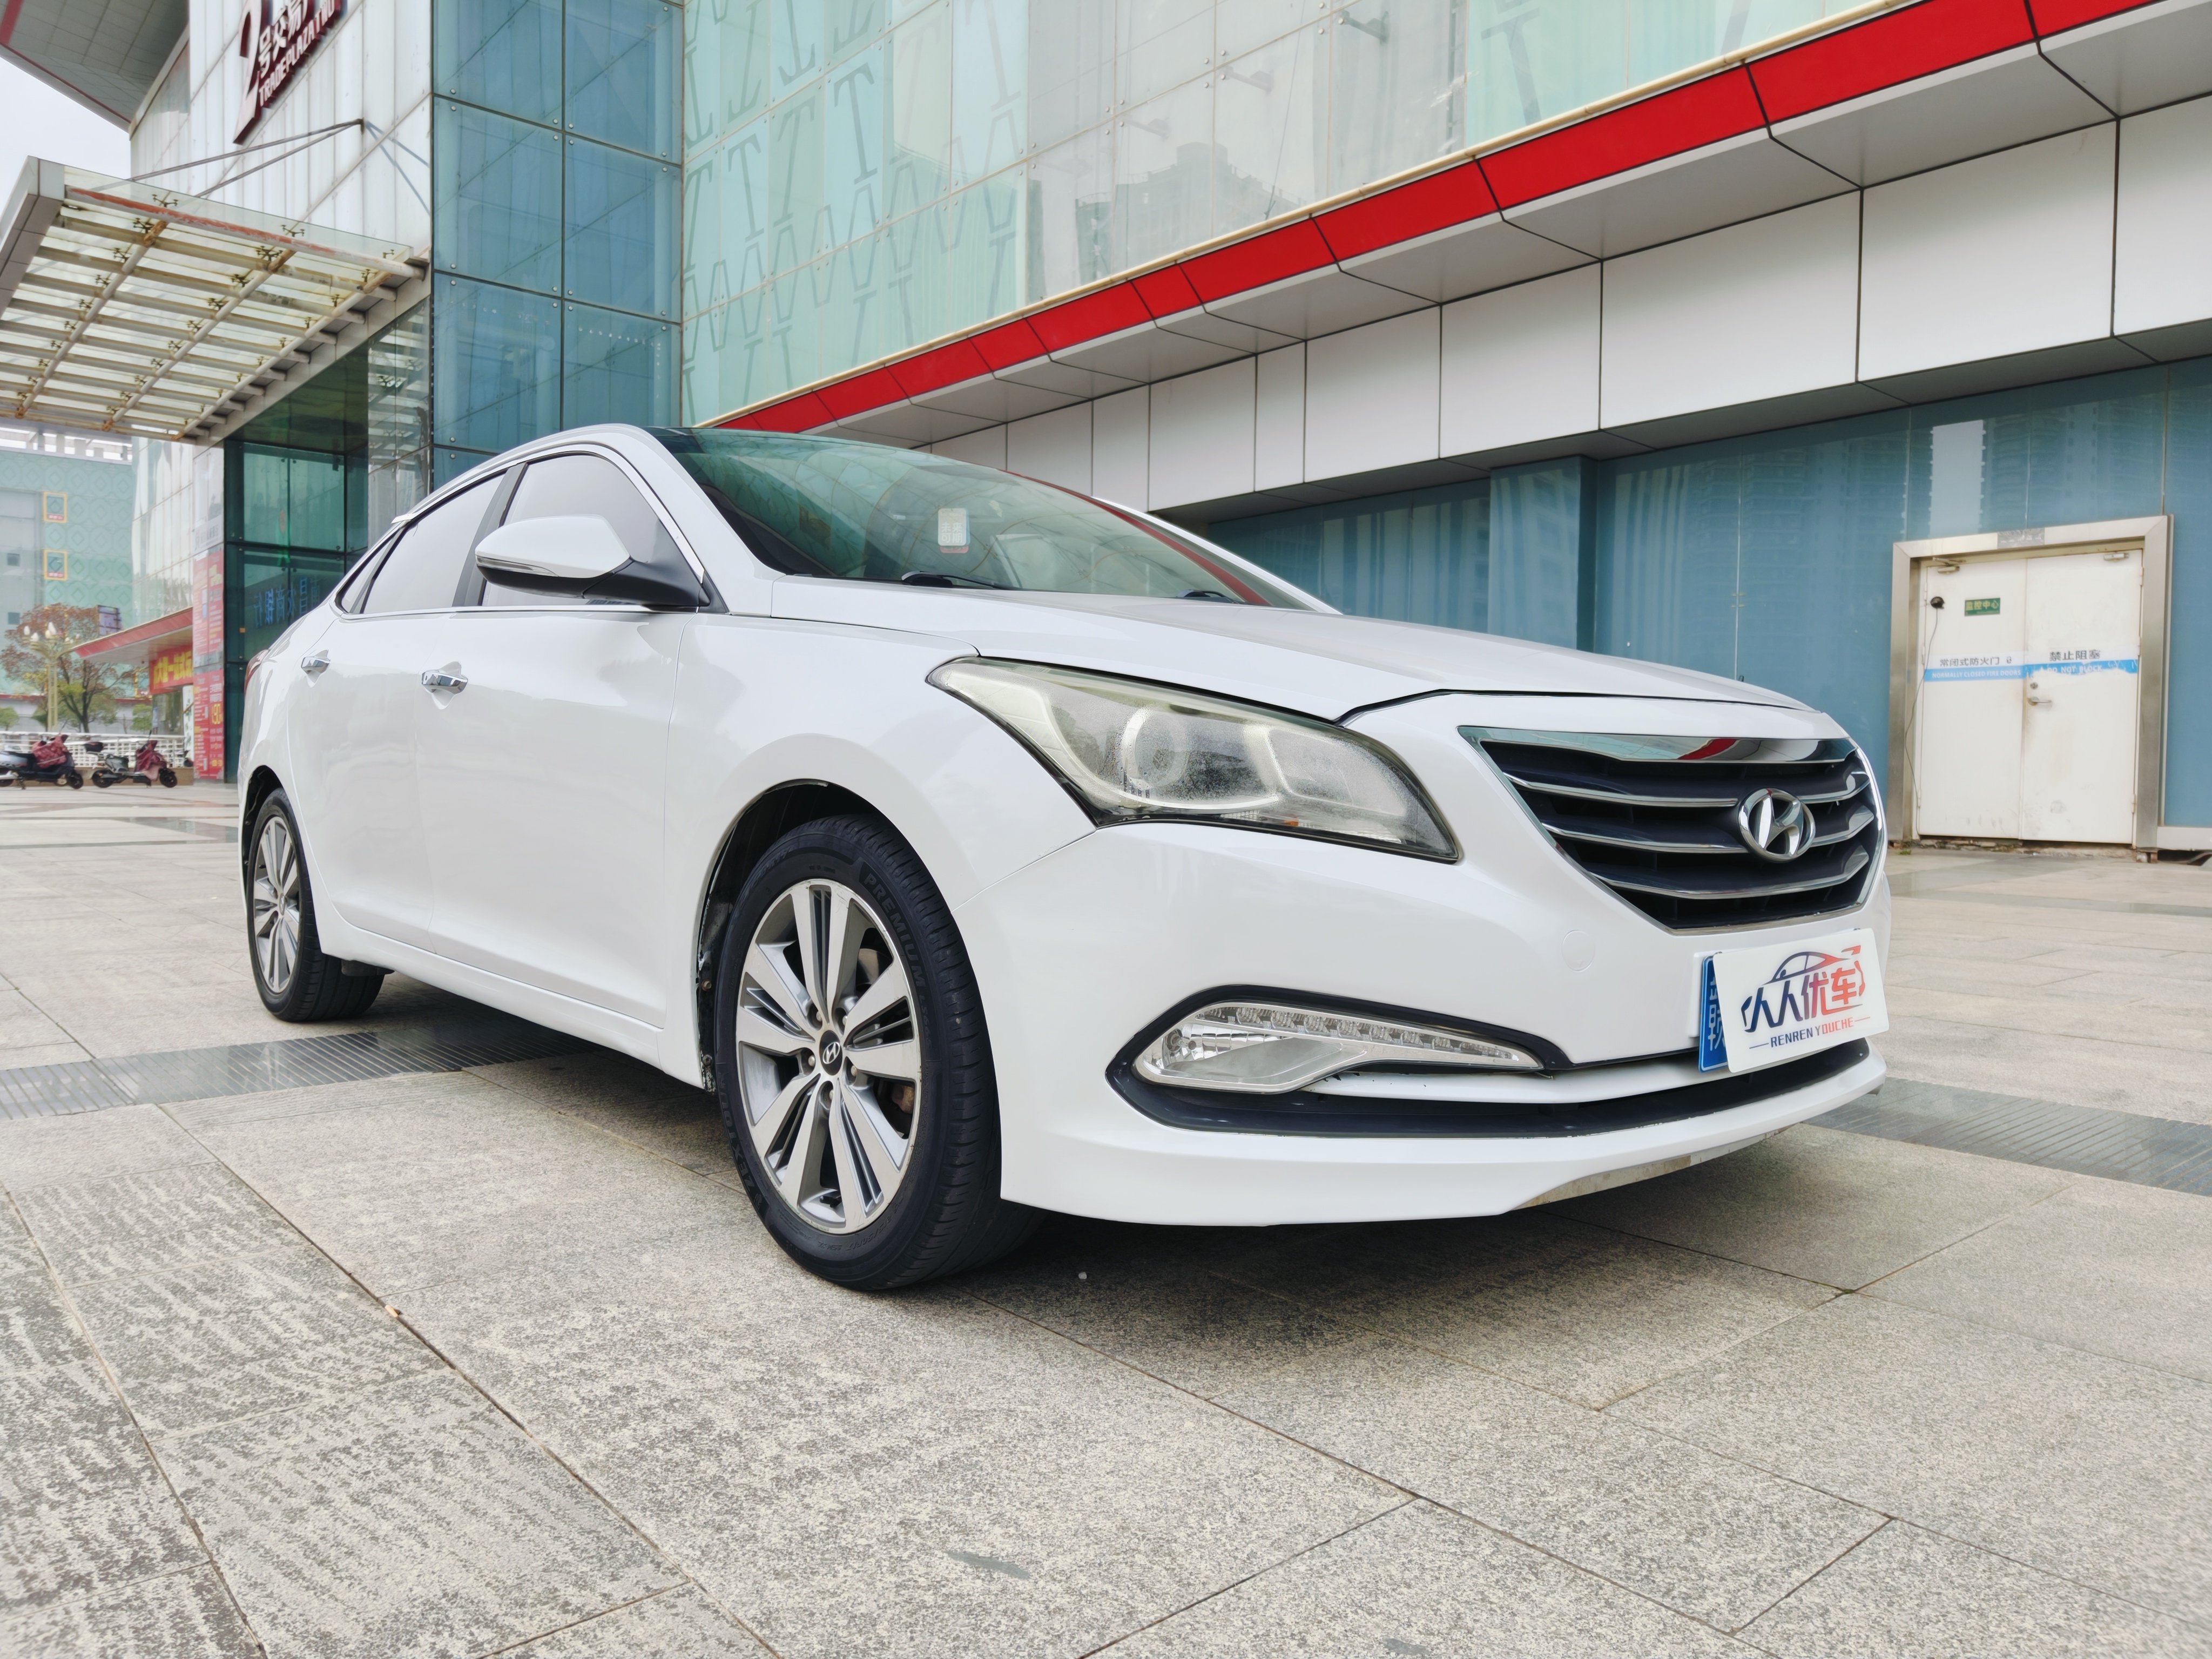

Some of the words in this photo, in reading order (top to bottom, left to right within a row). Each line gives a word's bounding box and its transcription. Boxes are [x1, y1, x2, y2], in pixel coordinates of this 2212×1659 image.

[941, 522, 963, 532] 未来
[941, 533, 963, 543] 可期
[1966, 600, 1999, 610] 监控中心
[1940, 657, 2000, 667] 常闭式防火门
[864, 873, 926, 988] PREMIUM
[1770, 1028, 1813, 1048] RENREN
[1815, 1017, 1854, 1036] YOUCHE
[718, 1071, 757, 1192] ZEXTOUR
